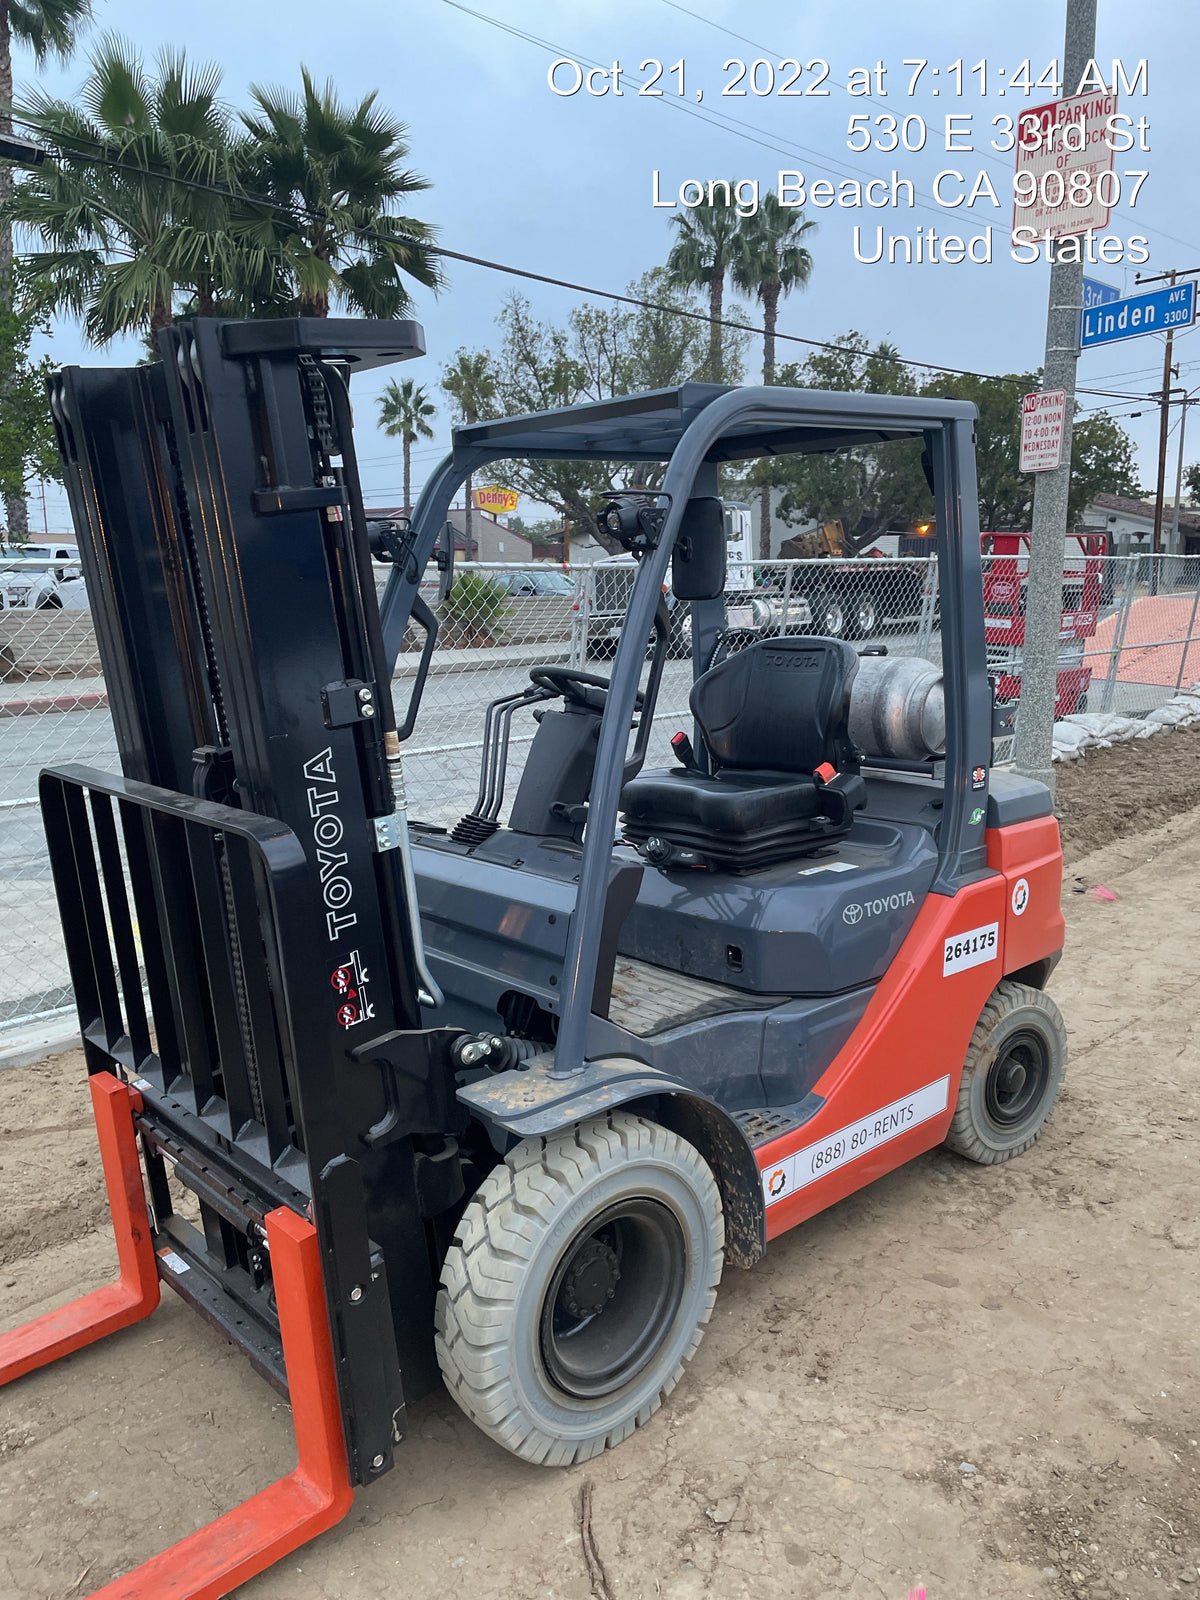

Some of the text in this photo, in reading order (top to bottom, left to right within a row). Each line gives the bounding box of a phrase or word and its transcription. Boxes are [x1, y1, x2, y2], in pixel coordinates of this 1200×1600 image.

[1058, 97, 1112, 125] PARKING
[1056, 153, 1072, 169] OF
[1082, 283, 1102, 307] 3rd
[1085, 288, 1187, 338] Linden AVE
[1163, 308, 1188, 325] 3300
[1025, 394, 1064, 412] NO PARKING
[1043, 411, 1062, 424] NOON
[1025, 429, 1032, 440] TO
[1051, 425, 1060, 436] PM
[1024, 439, 1059, 453] WEDNESDAY
[478, 491, 516, 507] Denny's
[765, 653, 819, 668] TOYOTA
[303, 746, 357, 941] TOYOTA
[864, 890, 915, 917] TOYOTA
[945, 930, 996, 962] 264175
[811, 1103, 915, 1175] (888) 80-RENTS
